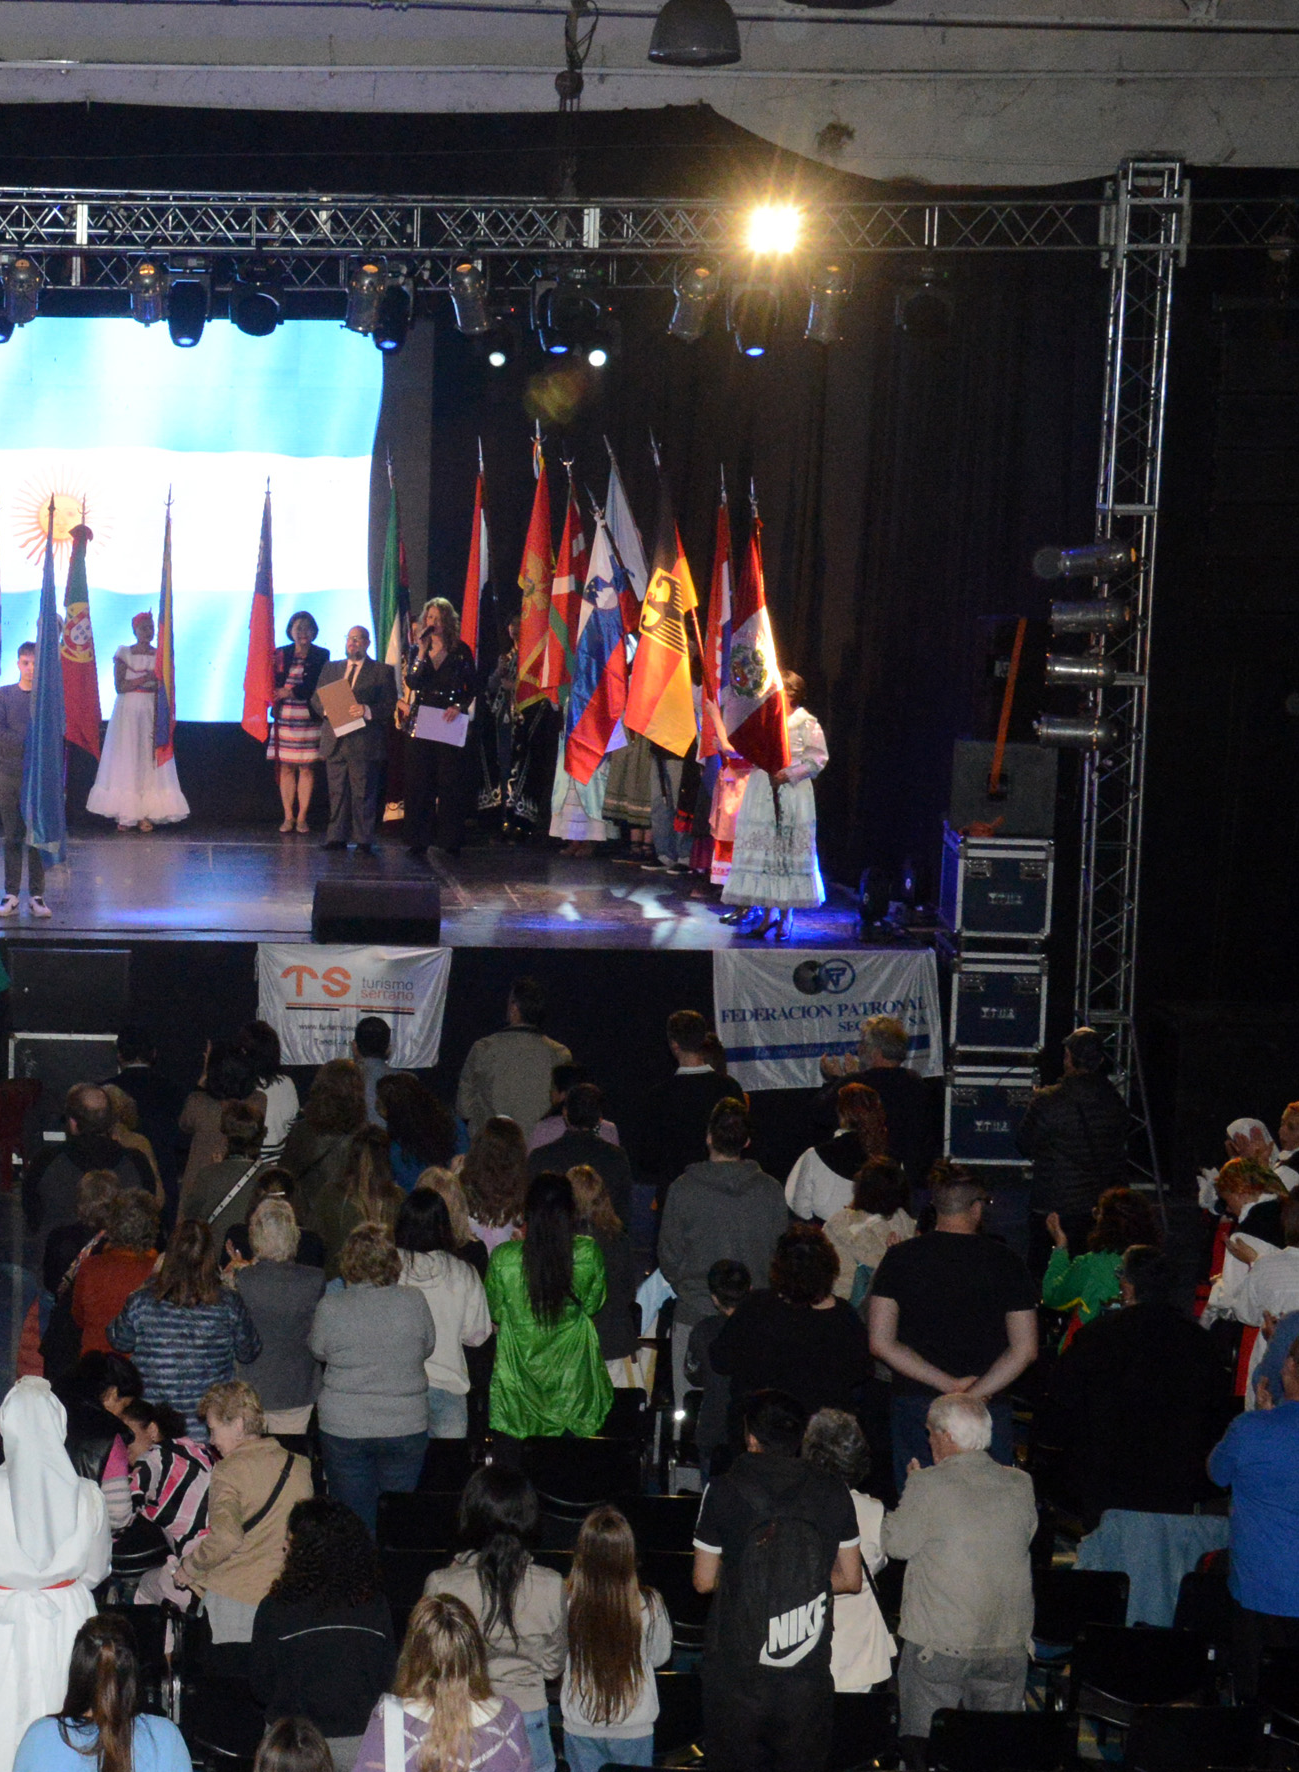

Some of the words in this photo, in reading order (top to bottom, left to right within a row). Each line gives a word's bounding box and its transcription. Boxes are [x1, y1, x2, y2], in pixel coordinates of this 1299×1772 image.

[280, 965, 352, 998] TS
[362, 976, 414, 991] turismo
[361, 989, 415, 1001] serrano
[720, 1004, 833, 1024] FEDERACION
[837, 997, 928, 1018] PATRONAL
